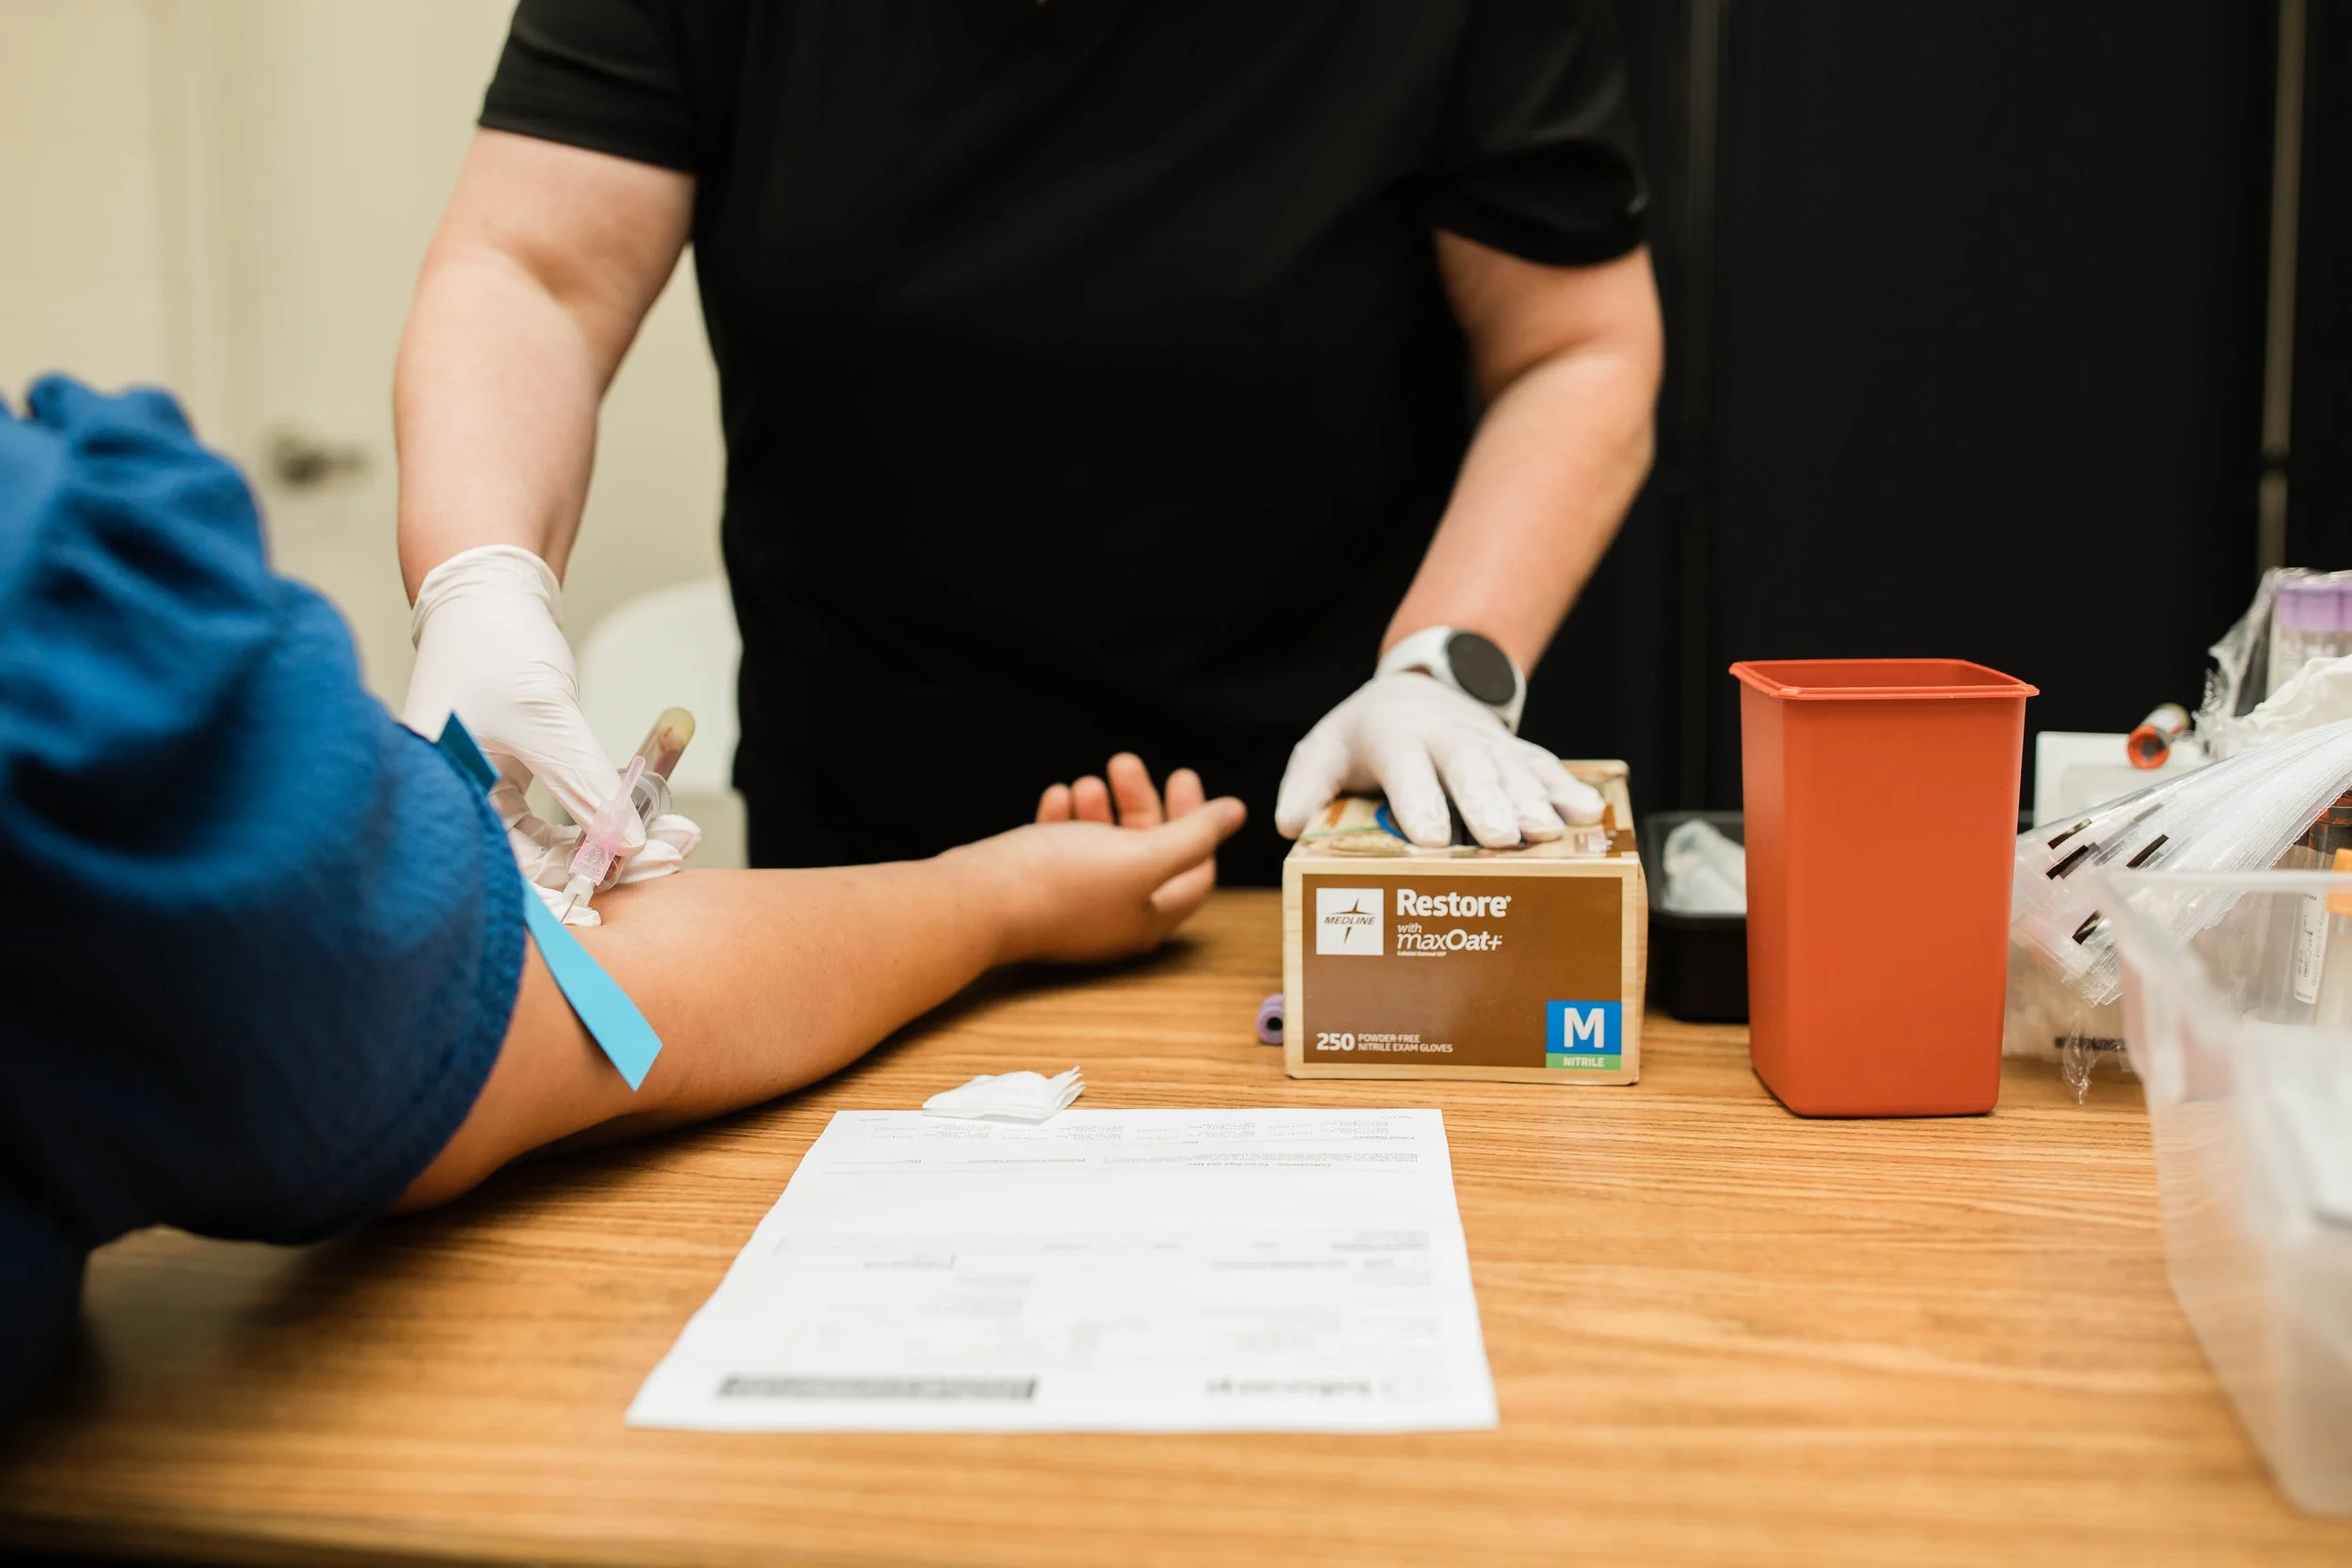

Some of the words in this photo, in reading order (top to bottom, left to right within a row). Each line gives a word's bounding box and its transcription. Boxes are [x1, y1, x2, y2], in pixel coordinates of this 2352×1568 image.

[1397, 889, 1508, 918] Restore
[1324, 915, 1376, 926] MEDLINE
[1397, 923, 1422, 933] with
[1564, 1007, 1605, 1049] M
[1316, 1033, 1356, 1051] 250
[1358, 1034, 1421, 1043] POWDER-FREE
[1358, 1043, 1391, 1052] NITRILE
[1392, 1043, 1419, 1052] EXAM
[1419, 1044, 1454, 1053] GLOVES
[1564, 1056, 1605, 1068] NITRILE
